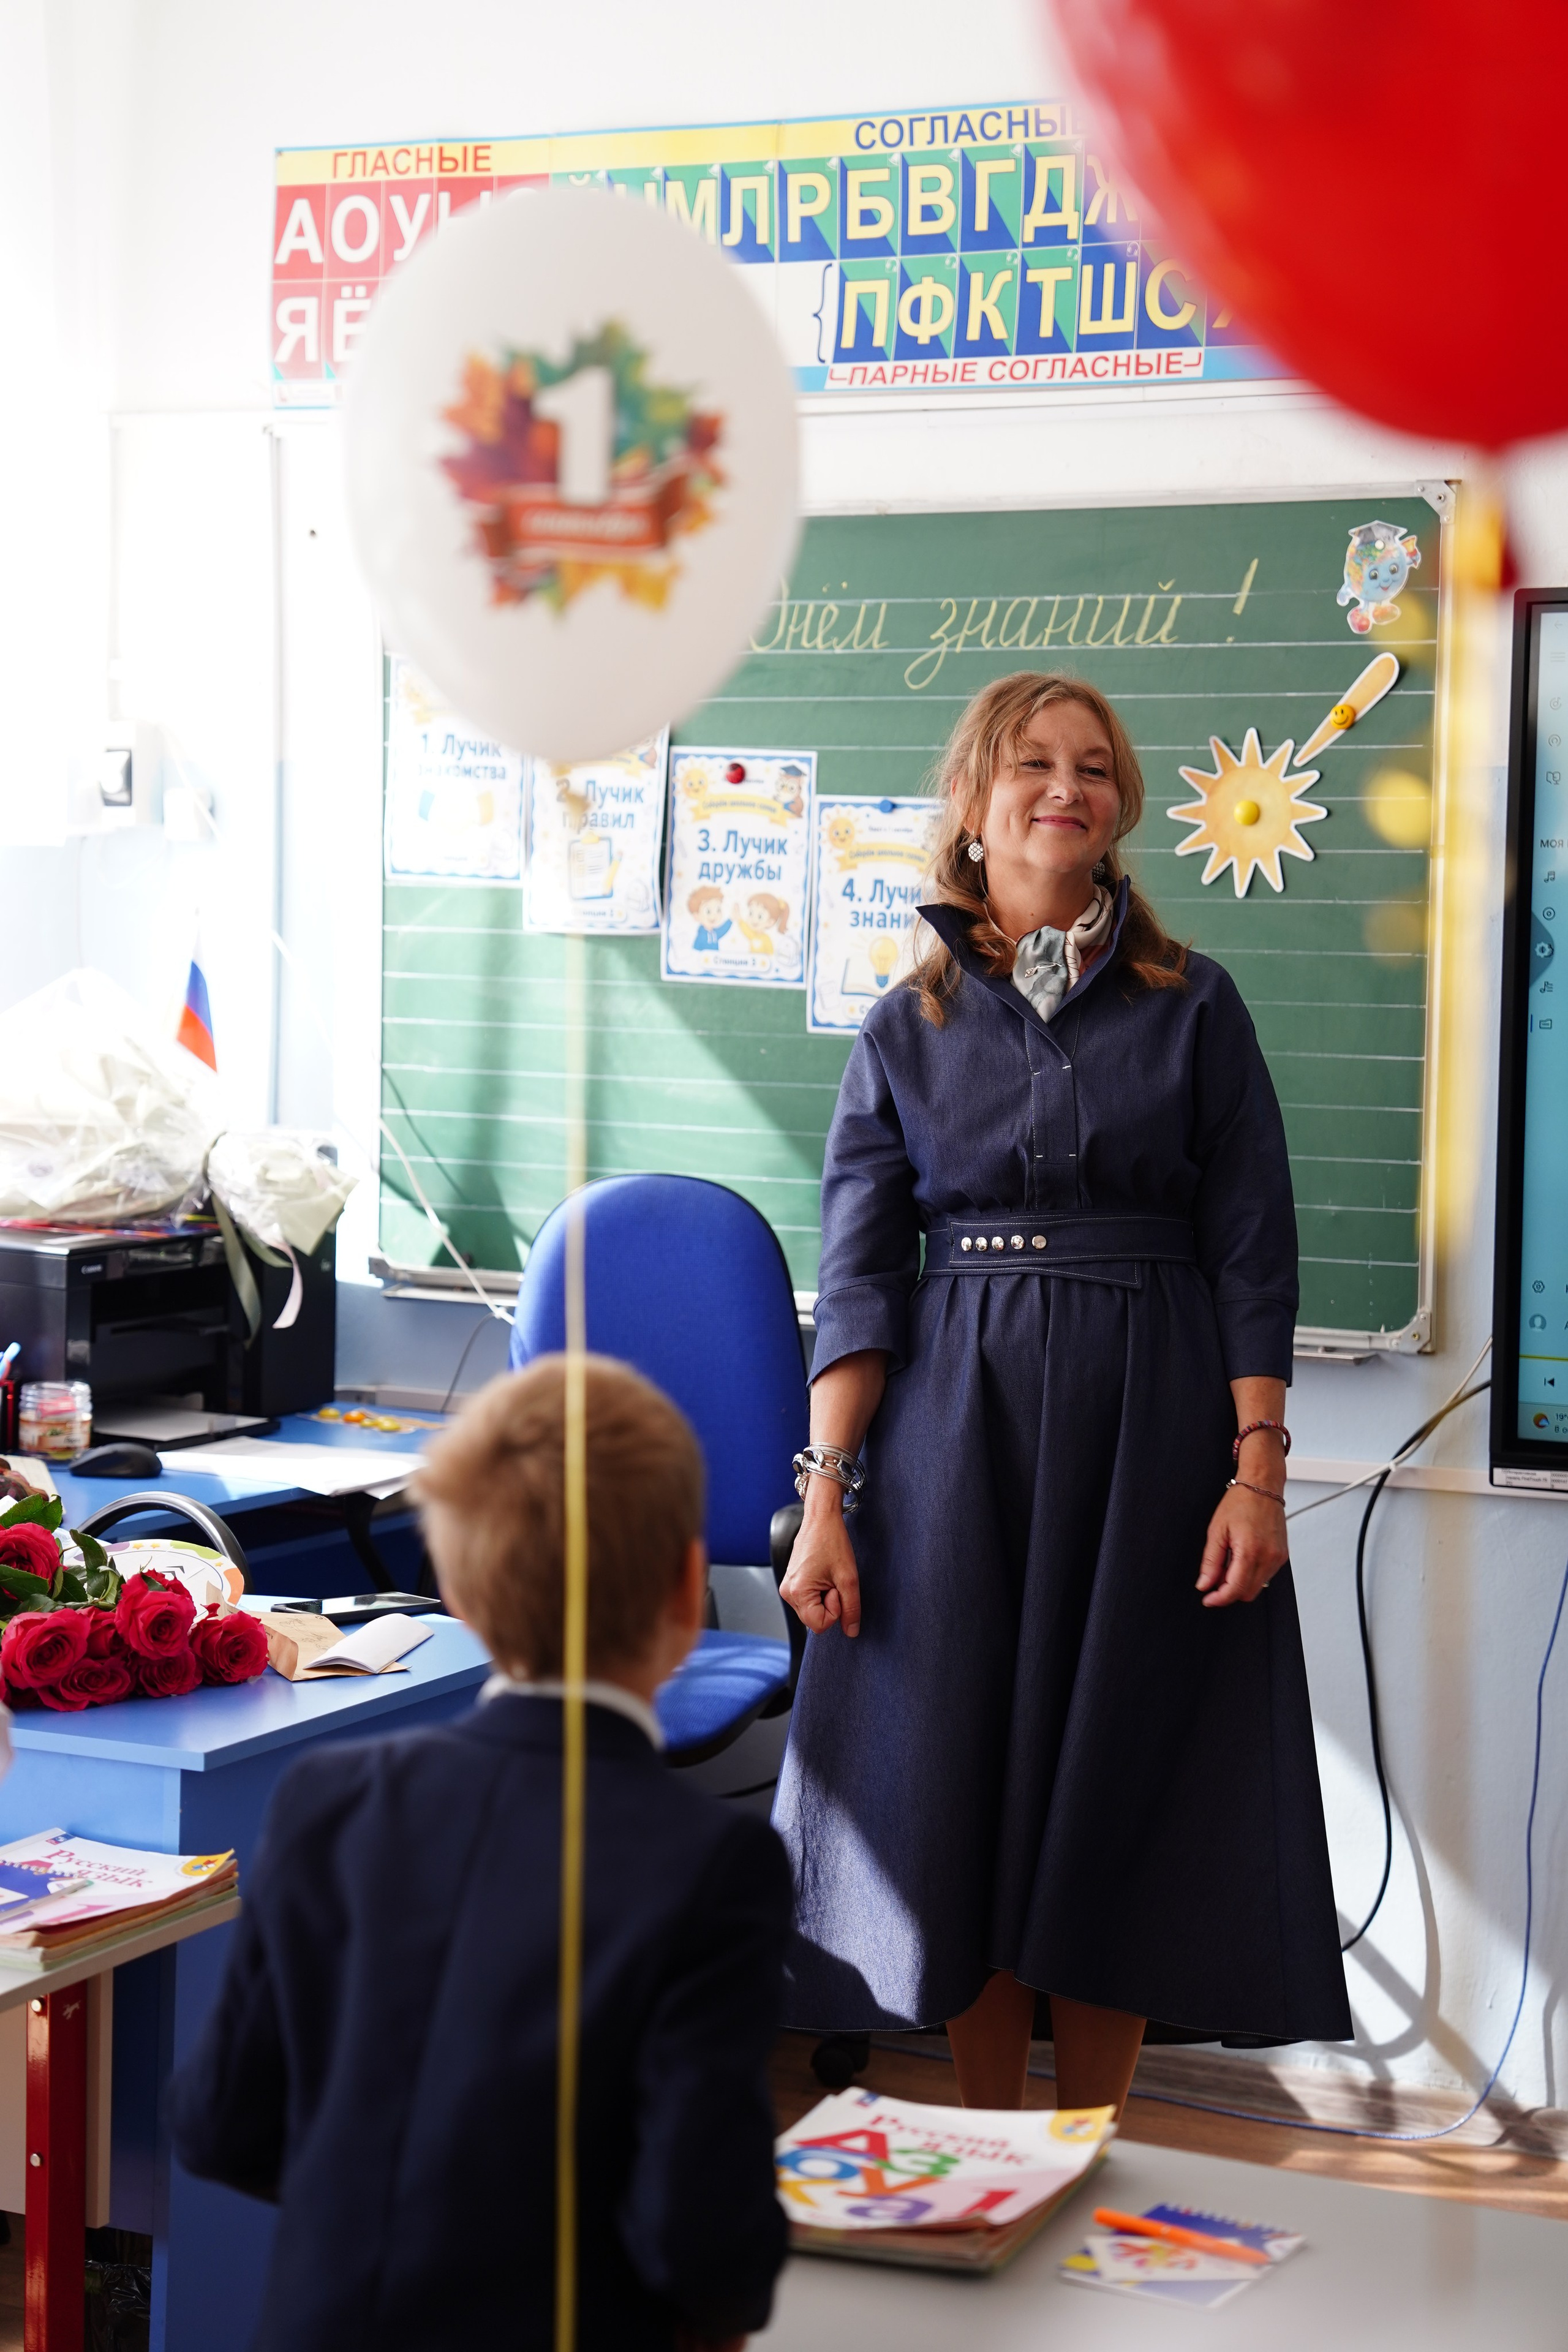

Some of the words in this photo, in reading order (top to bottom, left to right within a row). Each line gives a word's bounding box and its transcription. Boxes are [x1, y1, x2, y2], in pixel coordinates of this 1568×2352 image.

[333, 145, 492, 179] ГЛАСНЫЕ
[848, 361, 978, 386] ПАРНЫЕ
[988, 351, 1184, 382] СОГЛАСНЫЕ
[534, 368, 612, 506] 1
[904, 578, 1182, 690] знаний
[442, 733, 502, 761] Лучик
[585, 779, 644, 810] Лучик
[698, 828, 717, 852] 3.
[723, 830, 788, 859] Лучик
[1540, 839, 1564, 848] МОЯ
[698, 859, 782, 884] дружбы
[841, 878, 862, 903] 4.
[869, 879, 922, 910] Лучи
[850, 911, 914, 929] знани
[1555, 1412, 1568, 1422] 19°
[42, 1849, 149, 1876] Русский
[77, 1869, 153, 1888] язык
